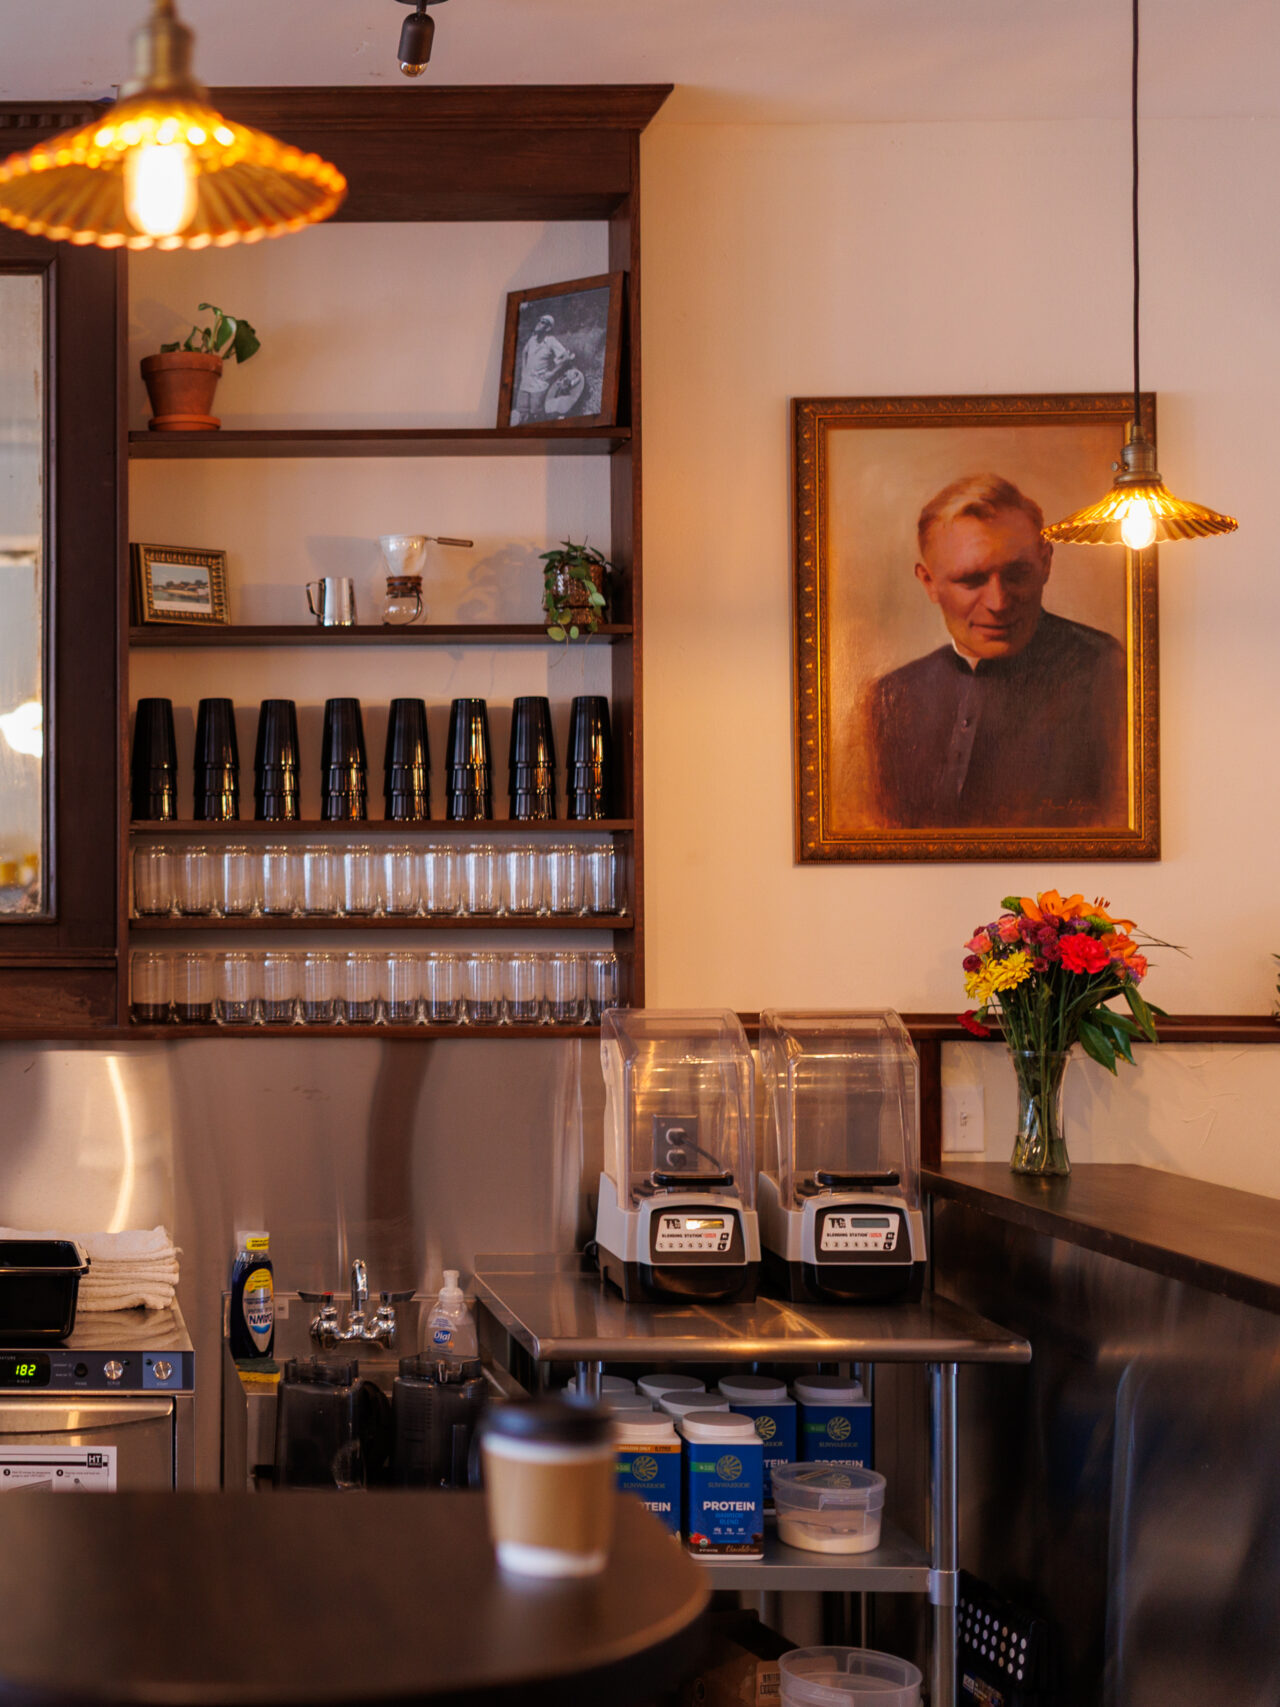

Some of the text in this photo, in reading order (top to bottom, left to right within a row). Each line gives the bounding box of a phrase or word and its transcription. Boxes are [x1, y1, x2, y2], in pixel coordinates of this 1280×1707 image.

[433, 1330, 451, 1341] Dial
[15, 1363, 36, 1376] 182
[88, 1455, 102, 1464] HT
[763, 1459, 788, 1468] TEIN
[643, 1502, 671, 1512] TEIN
[702, 1501, 756, 1511] PROTEIN
